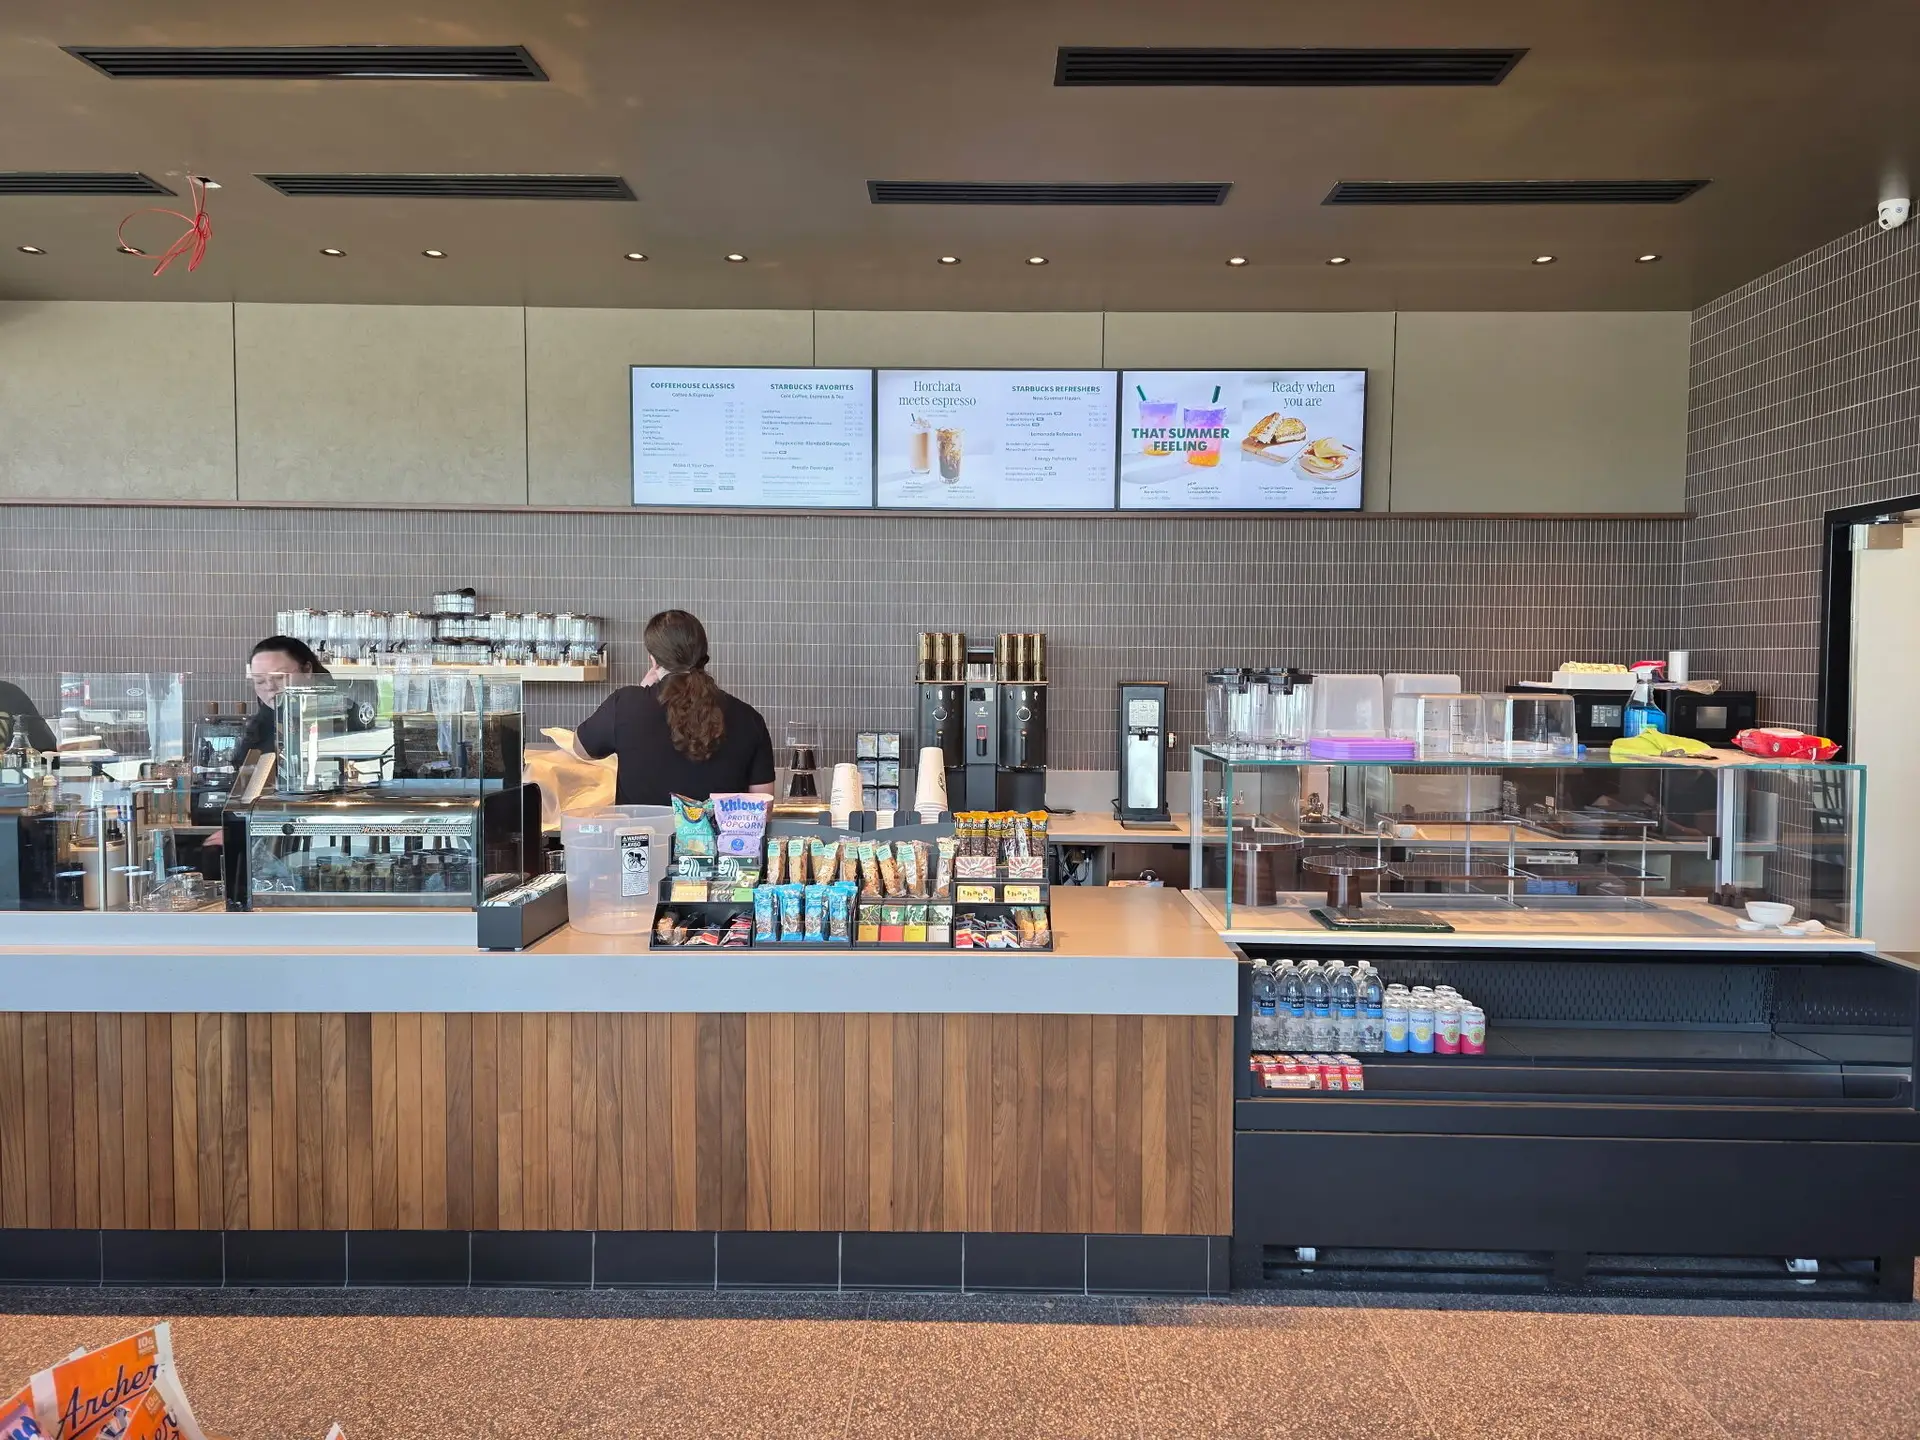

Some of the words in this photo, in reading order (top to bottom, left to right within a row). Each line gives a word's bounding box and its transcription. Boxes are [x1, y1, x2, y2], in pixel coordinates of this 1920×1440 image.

[913, 380, 962, 392] Horchata
[1272, 381, 1304, 394] Ready
[1307, 381, 1335, 393] when
[898, 396, 930, 406] meets
[932, 396, 977, 408] espresso
[1284, 397, 1303, 408] you
[1305, 397, 1322, 407] are
[1132, 428, 1167, 439] THAT
[1168, 428, 1230, 439] SUMMER
[1153, 440, 1208, 452] FEELING
[720, 820, 764, 829] POPCORN
[57, 1364, 159, 1438] Archer
